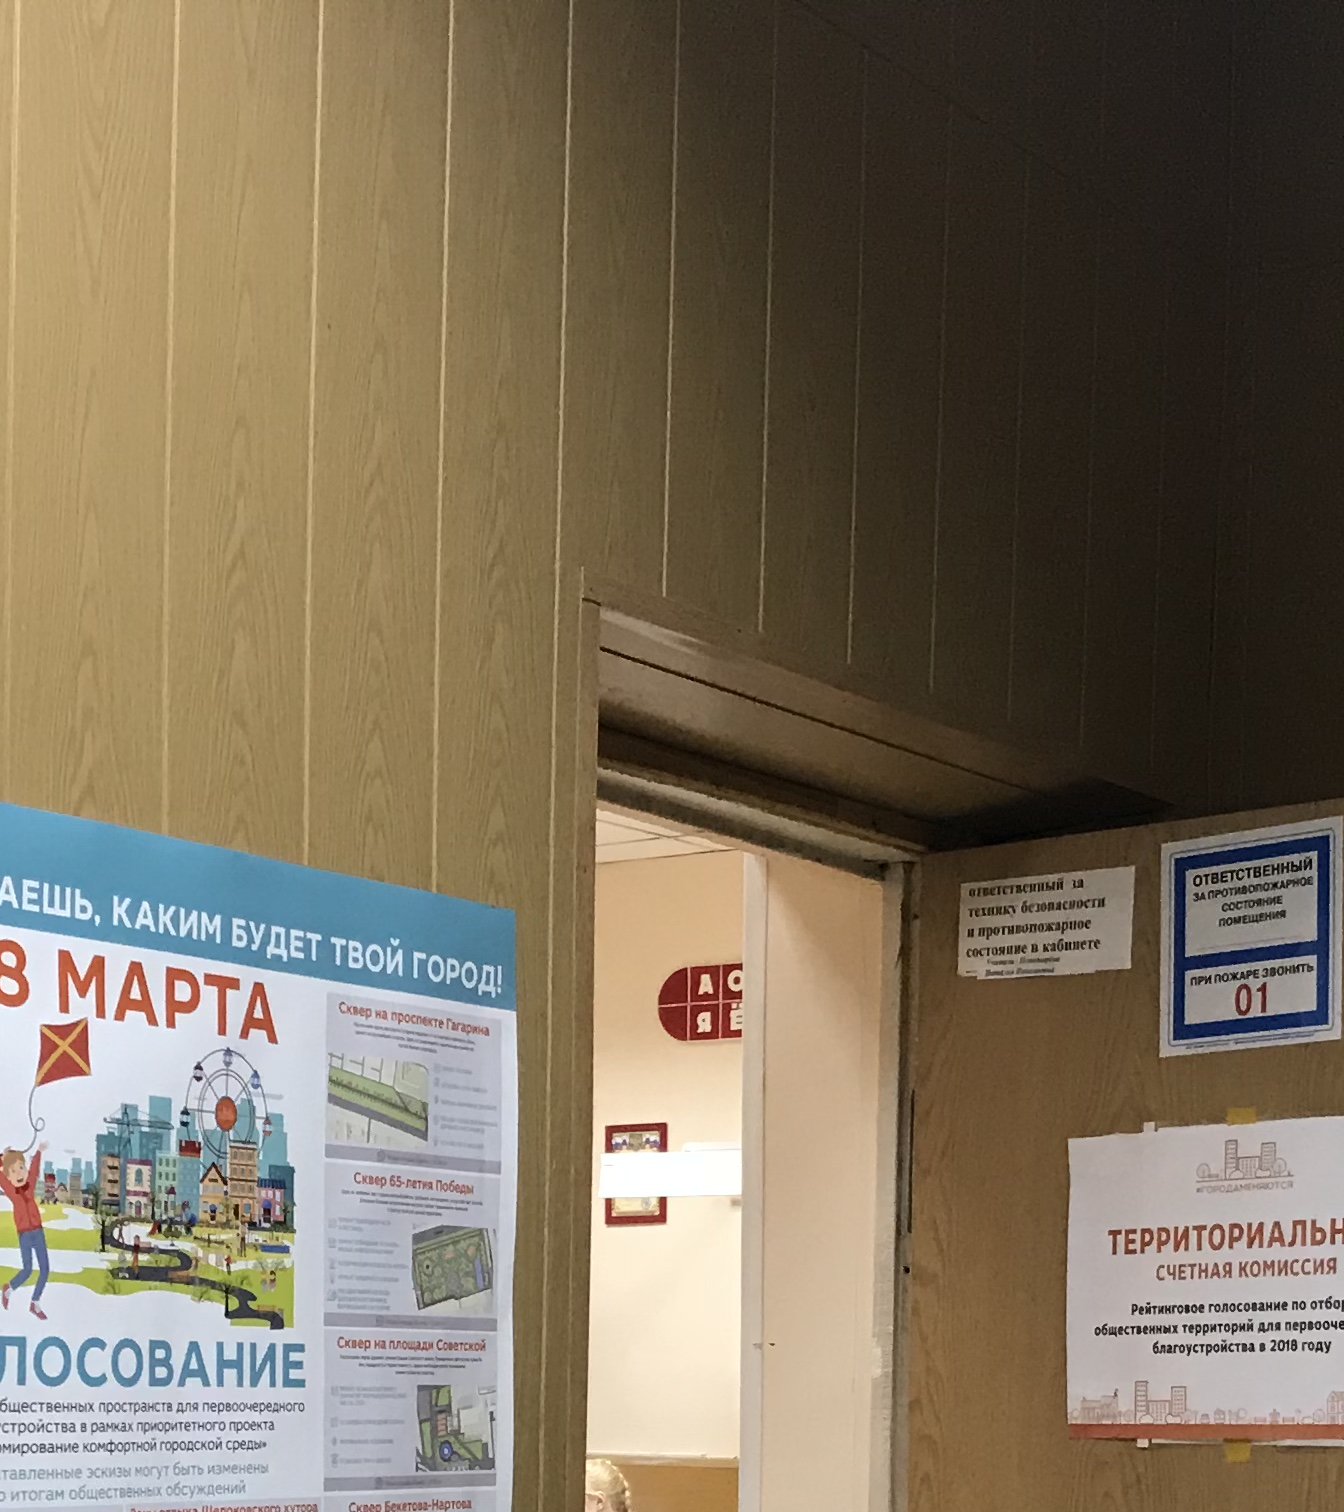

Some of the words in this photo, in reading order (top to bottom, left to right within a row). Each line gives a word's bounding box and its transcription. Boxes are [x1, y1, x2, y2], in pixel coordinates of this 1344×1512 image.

[1193, 857, 1313, 887] ОТВЕТСТВЕННЫЙ
[969, 878, 1064, 898] ответственный
[1071, 878, 1084, 889] за
[1193, 892, 1207, 902] ЗА
[1208, 876, 1313, 898] ПРОТИВОПОЖАРНОЕ
[968, 905, 1017, 918] технику
[1021, 896, 1106, 914] безопасности
[1221, 895, 1282, 912] СОСТОЯНИЕ
[1219, 910, 1286, 927] ПОМЕЩЕНИЯ
[967, 927, 974, 938] и
[978, 918, 1091, 940] противопожарное
[113, 895, 222, 943] КАКИМ
[232, 918, 322, 961] БУДЕТ
[331, 936, 403, 977] ТВОЙ
[412, 950, 502, 997] ГОРОД!
[966, 943, 1027, 958] состояние
[1031, 943, 1038, 953] в
[1042, 937, 1101, 953] кабинете
[1190, 974, 1212, 987] ПРИ
[1214, 969, 1260, 984] ПОЖАРЕ
[1262, 963, 1314, 978] ЗВОНИТЬ
[57, 948, 278, 1045] МАРТА
[1235, 982, 1268, 1016] 01
[339, 1002, 372, 1019] Сквер
[375, 1011, 388, 1020] на
[391, 1012, 443, 1029] проспекте
[446, 1019, 489, 1036] Гагарина
[354, 1172, 387, 1189] Сквер
[389, 1175, 433, 1190] 65-летия
[436, 1180, 473, 1194] Победы
[1196, 1181, 1293, 1193] #ГОРОДАМЕНЯЮТСЯ
[1156, 1262, 1232, 1281] СЧЕТНАЯ
[1238, 1258, 1337, 1278] КОМИССИЯ
[1131, 1302, 1204, 1316] Рейтинговое
[1209, 1300, 1288, 1313] голосование
[1292, 1300, 1307, 1311] по
[1094, 1323, 1178, 1336] общественных
[1182, 1319, 1254, 1335] территорий
[1258, 1320, 1281, 1333] для
[337, 1337, 371, 1352] Сквер
[374, 1340, 386, 1349] на
[389, 1340, 433, 1351] площади
[436, 1339, 486, 1351] Советской
[1152, 1341, 1255, 1356] благоустройства
[1259, 1343, 1266, 1352] в
[1270, 1339, 1298, 1352] 2018
[1302, 1341, 1331, 1354] году
[99, 1401, 172, 1414] пространств
[176, 1401, 198, 1413] для
[202, 1400, 305, 1415] первоочередного
[80, 1421, 87, 1432] в
[91, 1420, 133, 1434] рамках
[137, 1420, 225, 1433] приоритетного
[229, 1420, 275, 1433] проекта
[83, 1438, 157, 1453] комфортной
[160, 1438, 222, 1453] городской
[226, 1439, 267, 1452] среды»
[86, 1465, 132, 1479] эскизы
[135, 1464, 169, 1479] могут
[174, 1462, 203, 1476] быть
[207, 1462, 268, 1475] изменены
[10, 1489, 64, 1501] итогам
[69, 1484, 162, 1500] общественных
[166, 1481, 246, 1497] обсуждений
[385, 1499, 472, 1512] Бекетова-Нартова
